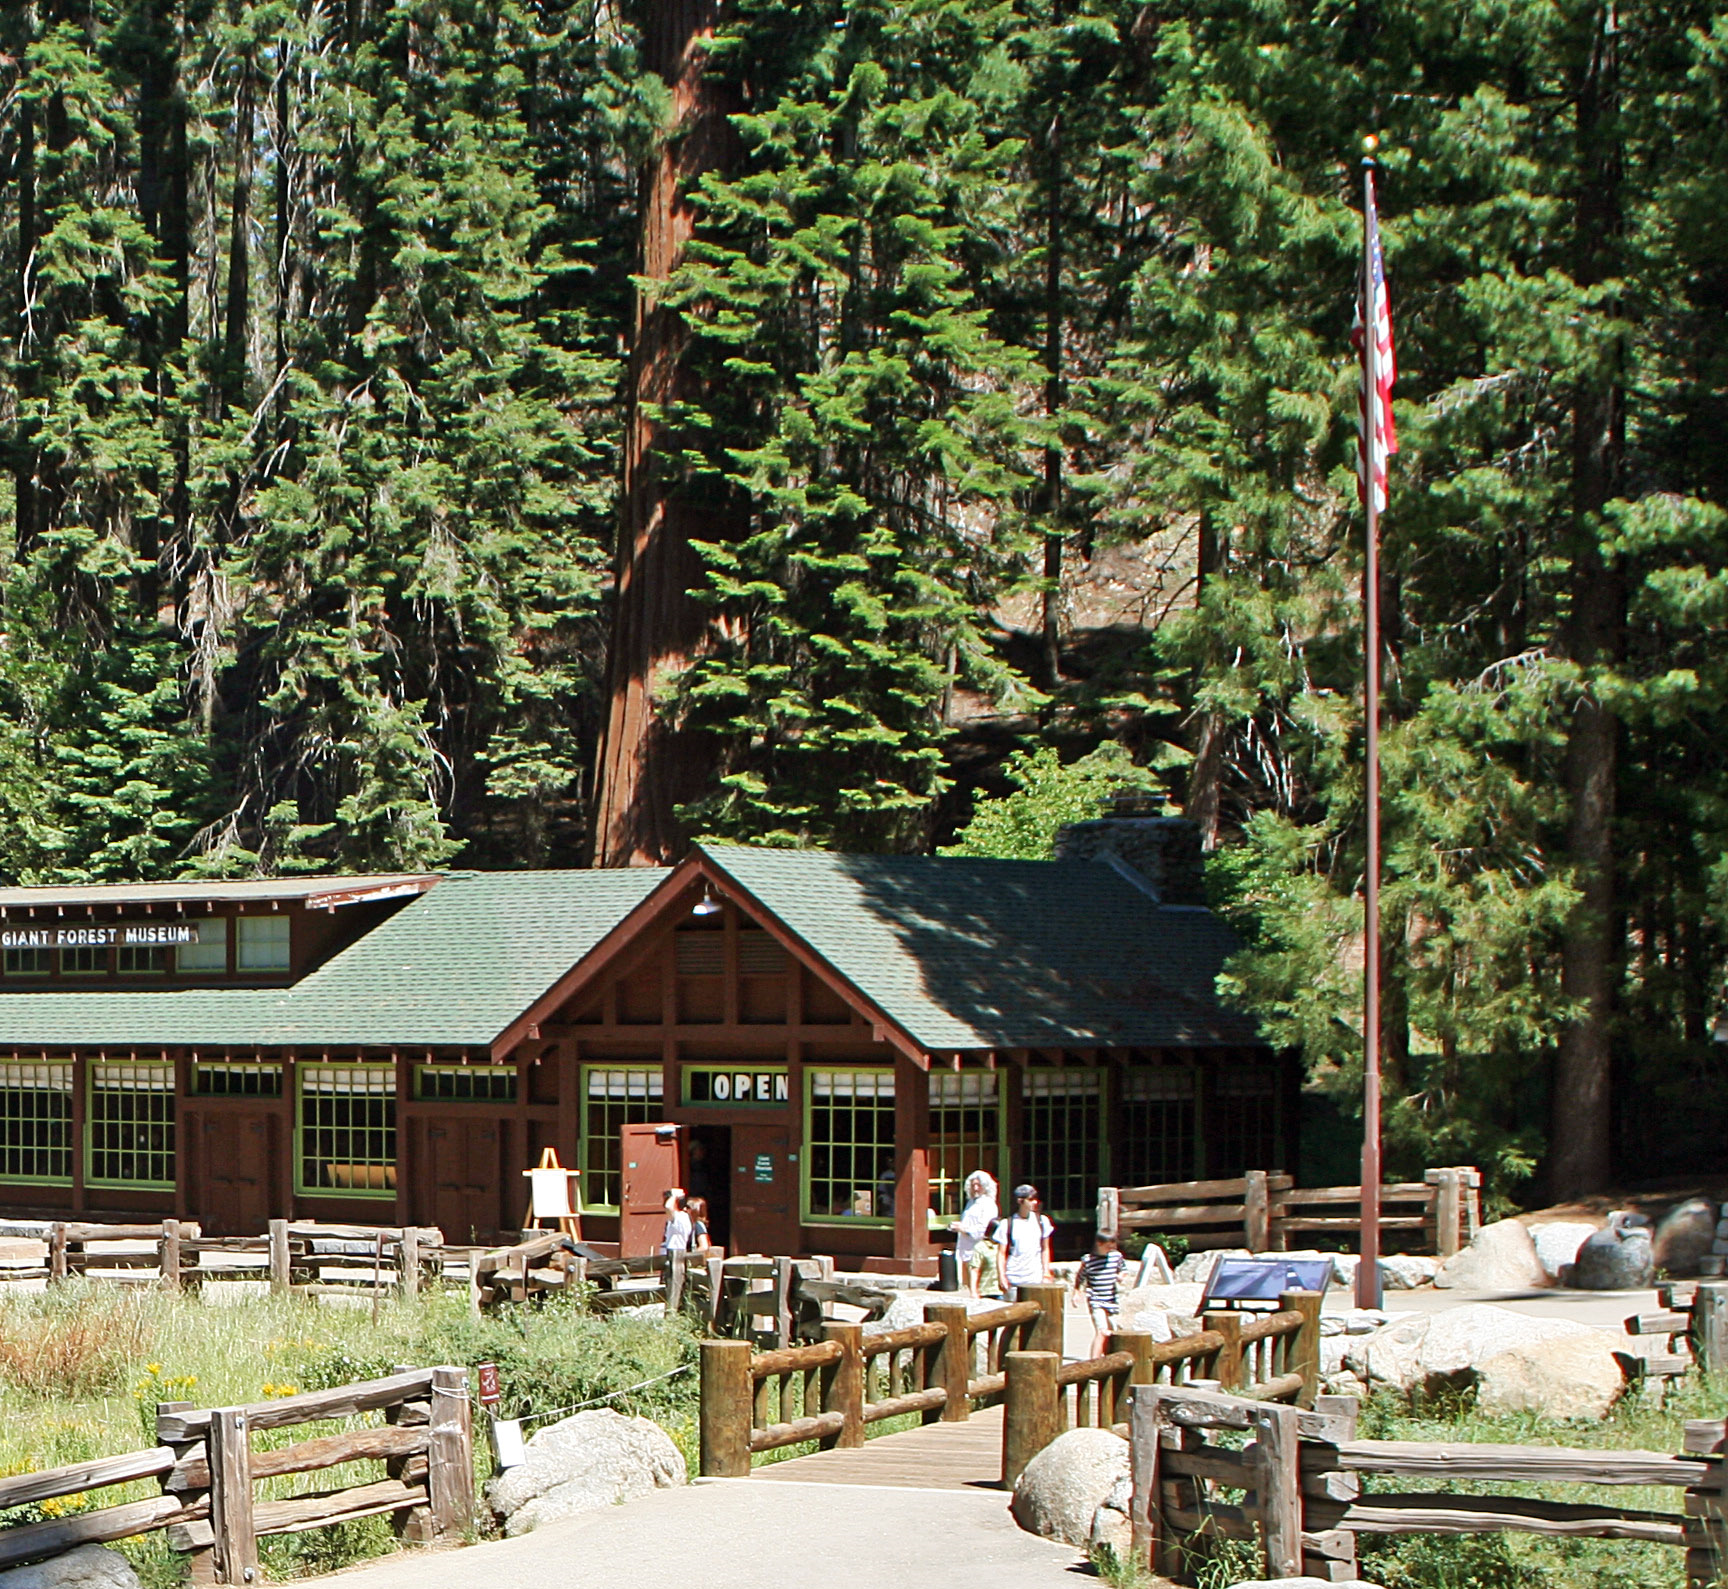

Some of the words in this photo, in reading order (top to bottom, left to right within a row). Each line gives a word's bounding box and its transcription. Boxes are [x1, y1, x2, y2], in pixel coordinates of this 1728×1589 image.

[1, 930, 49, 946] GIANT
[57, 928, 117, 945] FOREST
[125, 926, 190, 943] MUSEUM
[714, 1074, 789, 1100] OPEN
